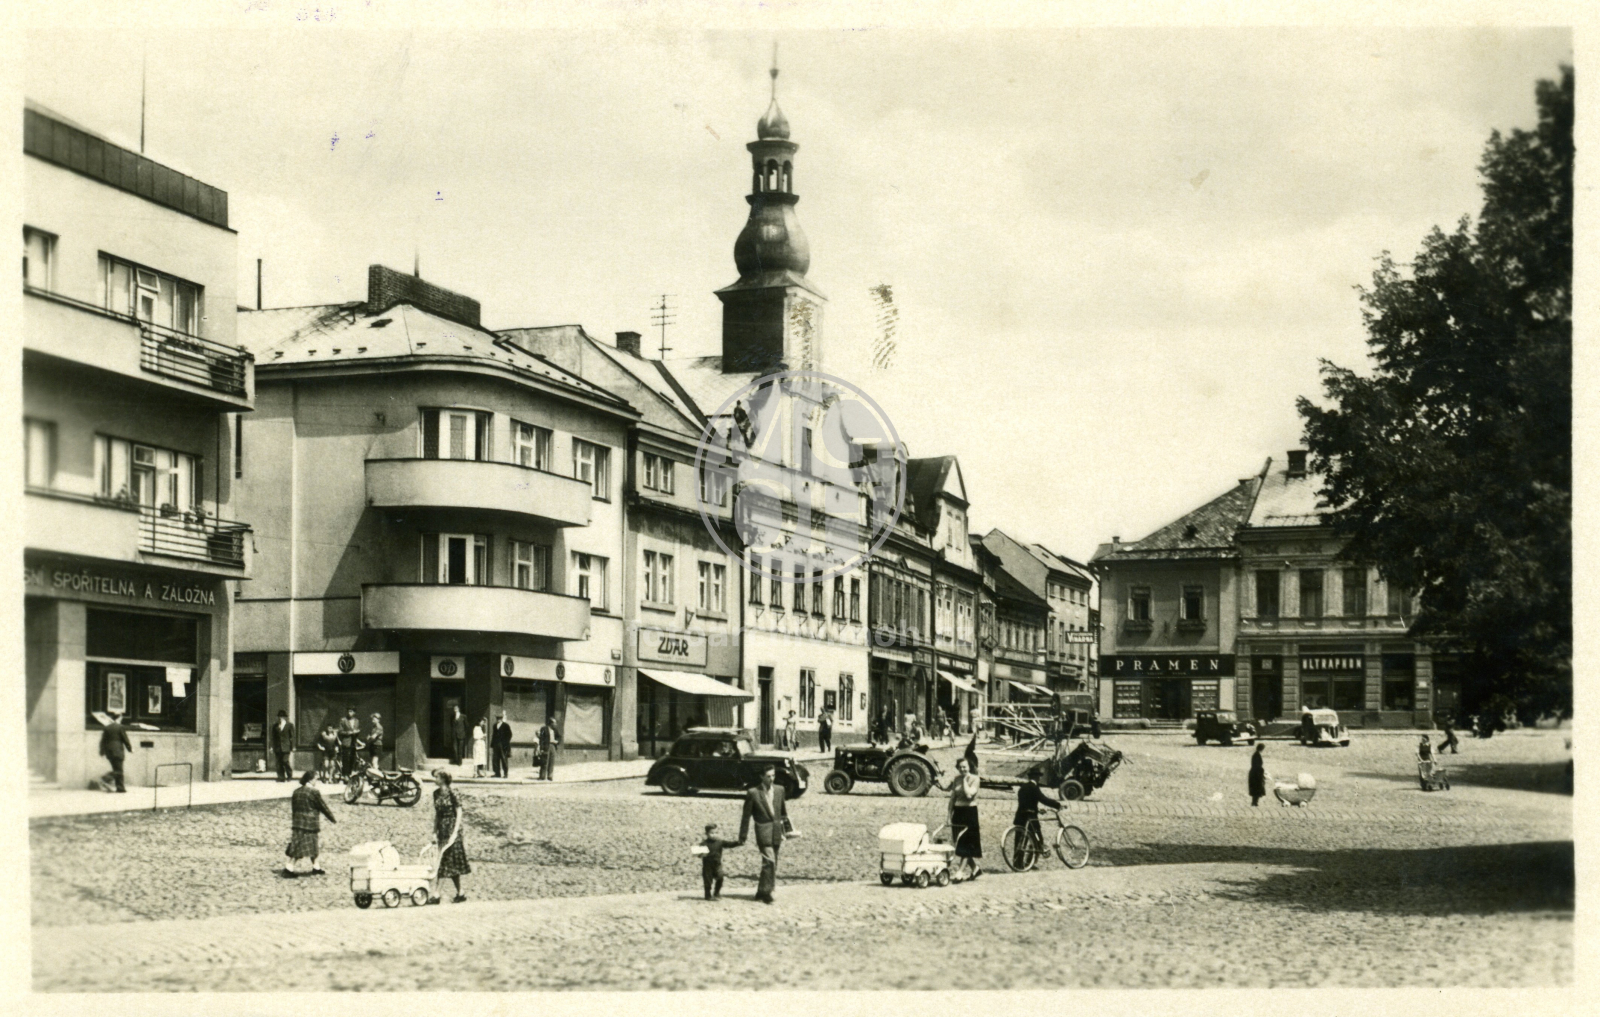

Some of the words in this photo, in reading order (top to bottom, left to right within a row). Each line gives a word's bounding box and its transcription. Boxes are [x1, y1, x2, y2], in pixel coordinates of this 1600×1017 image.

[53, 570, 136, 597] SPOŘITELNA
[144, 583, 153, 599] A
[161, 582, 216, 606] ZÁLOŽNA
[1115, 659, 1219, 671] PRAMEN
[1302, 658, 1363, 670] ULTRAPHON
